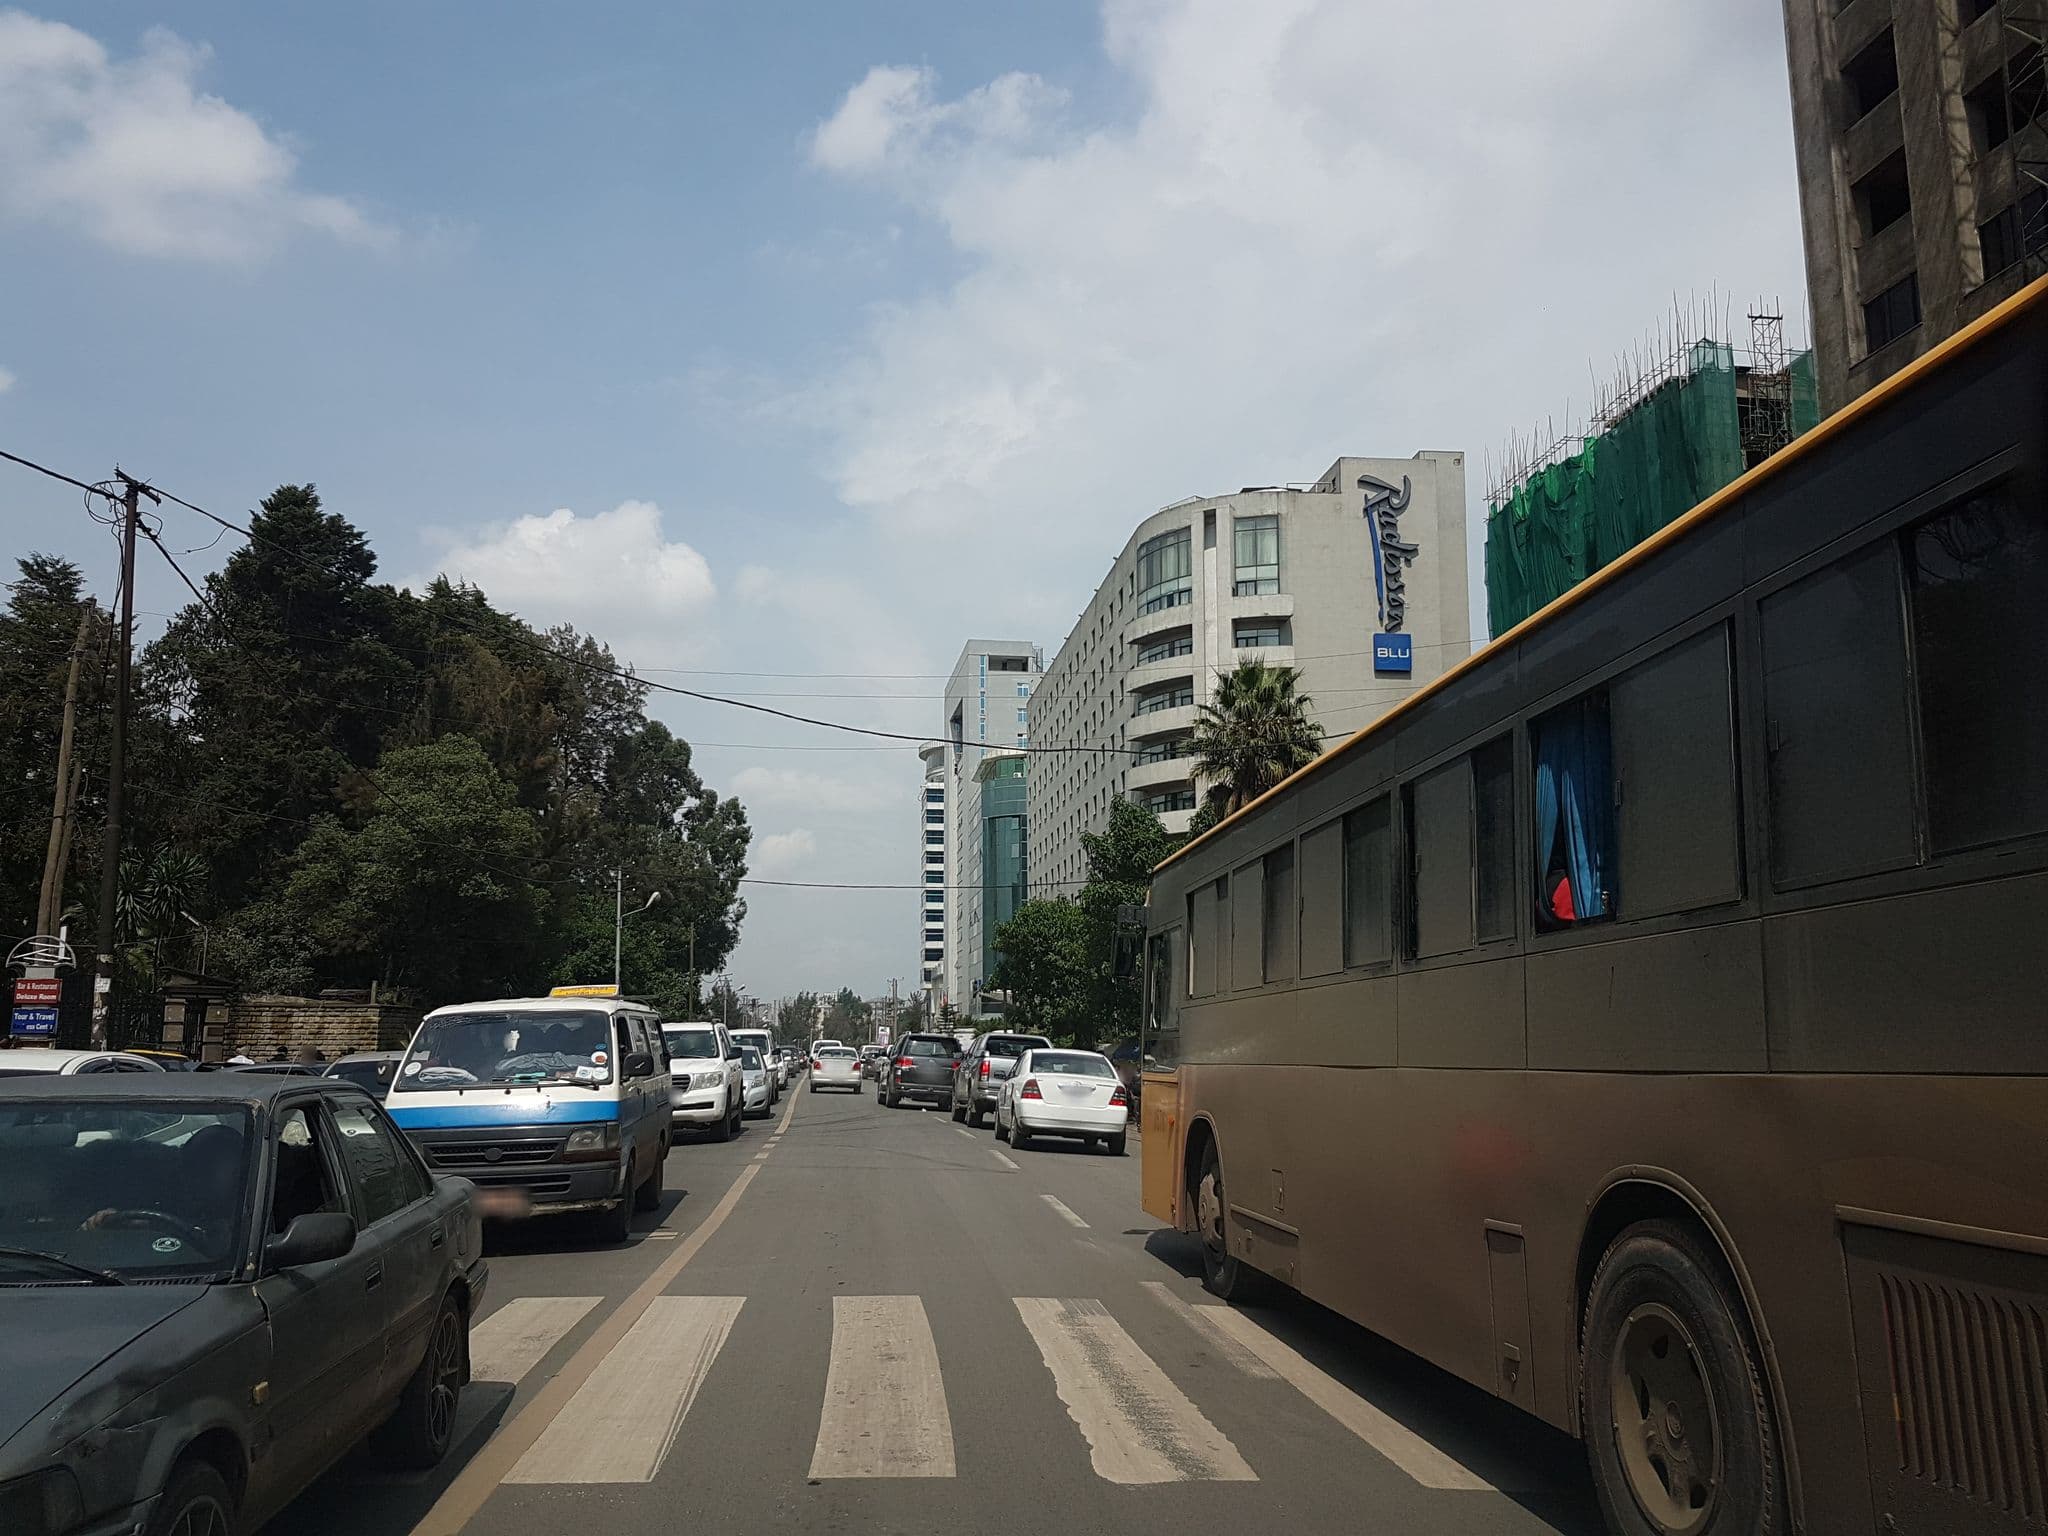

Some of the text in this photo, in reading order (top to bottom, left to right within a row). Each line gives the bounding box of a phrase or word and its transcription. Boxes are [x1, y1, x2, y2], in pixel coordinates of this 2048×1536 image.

[1357, 475, 1420, 632] Radisson
[1377, 647, 1409, 658] BLU
[31, 982, 58, 990] Restaurant
[14, 1012, 55, 1021] Tour & Travel
